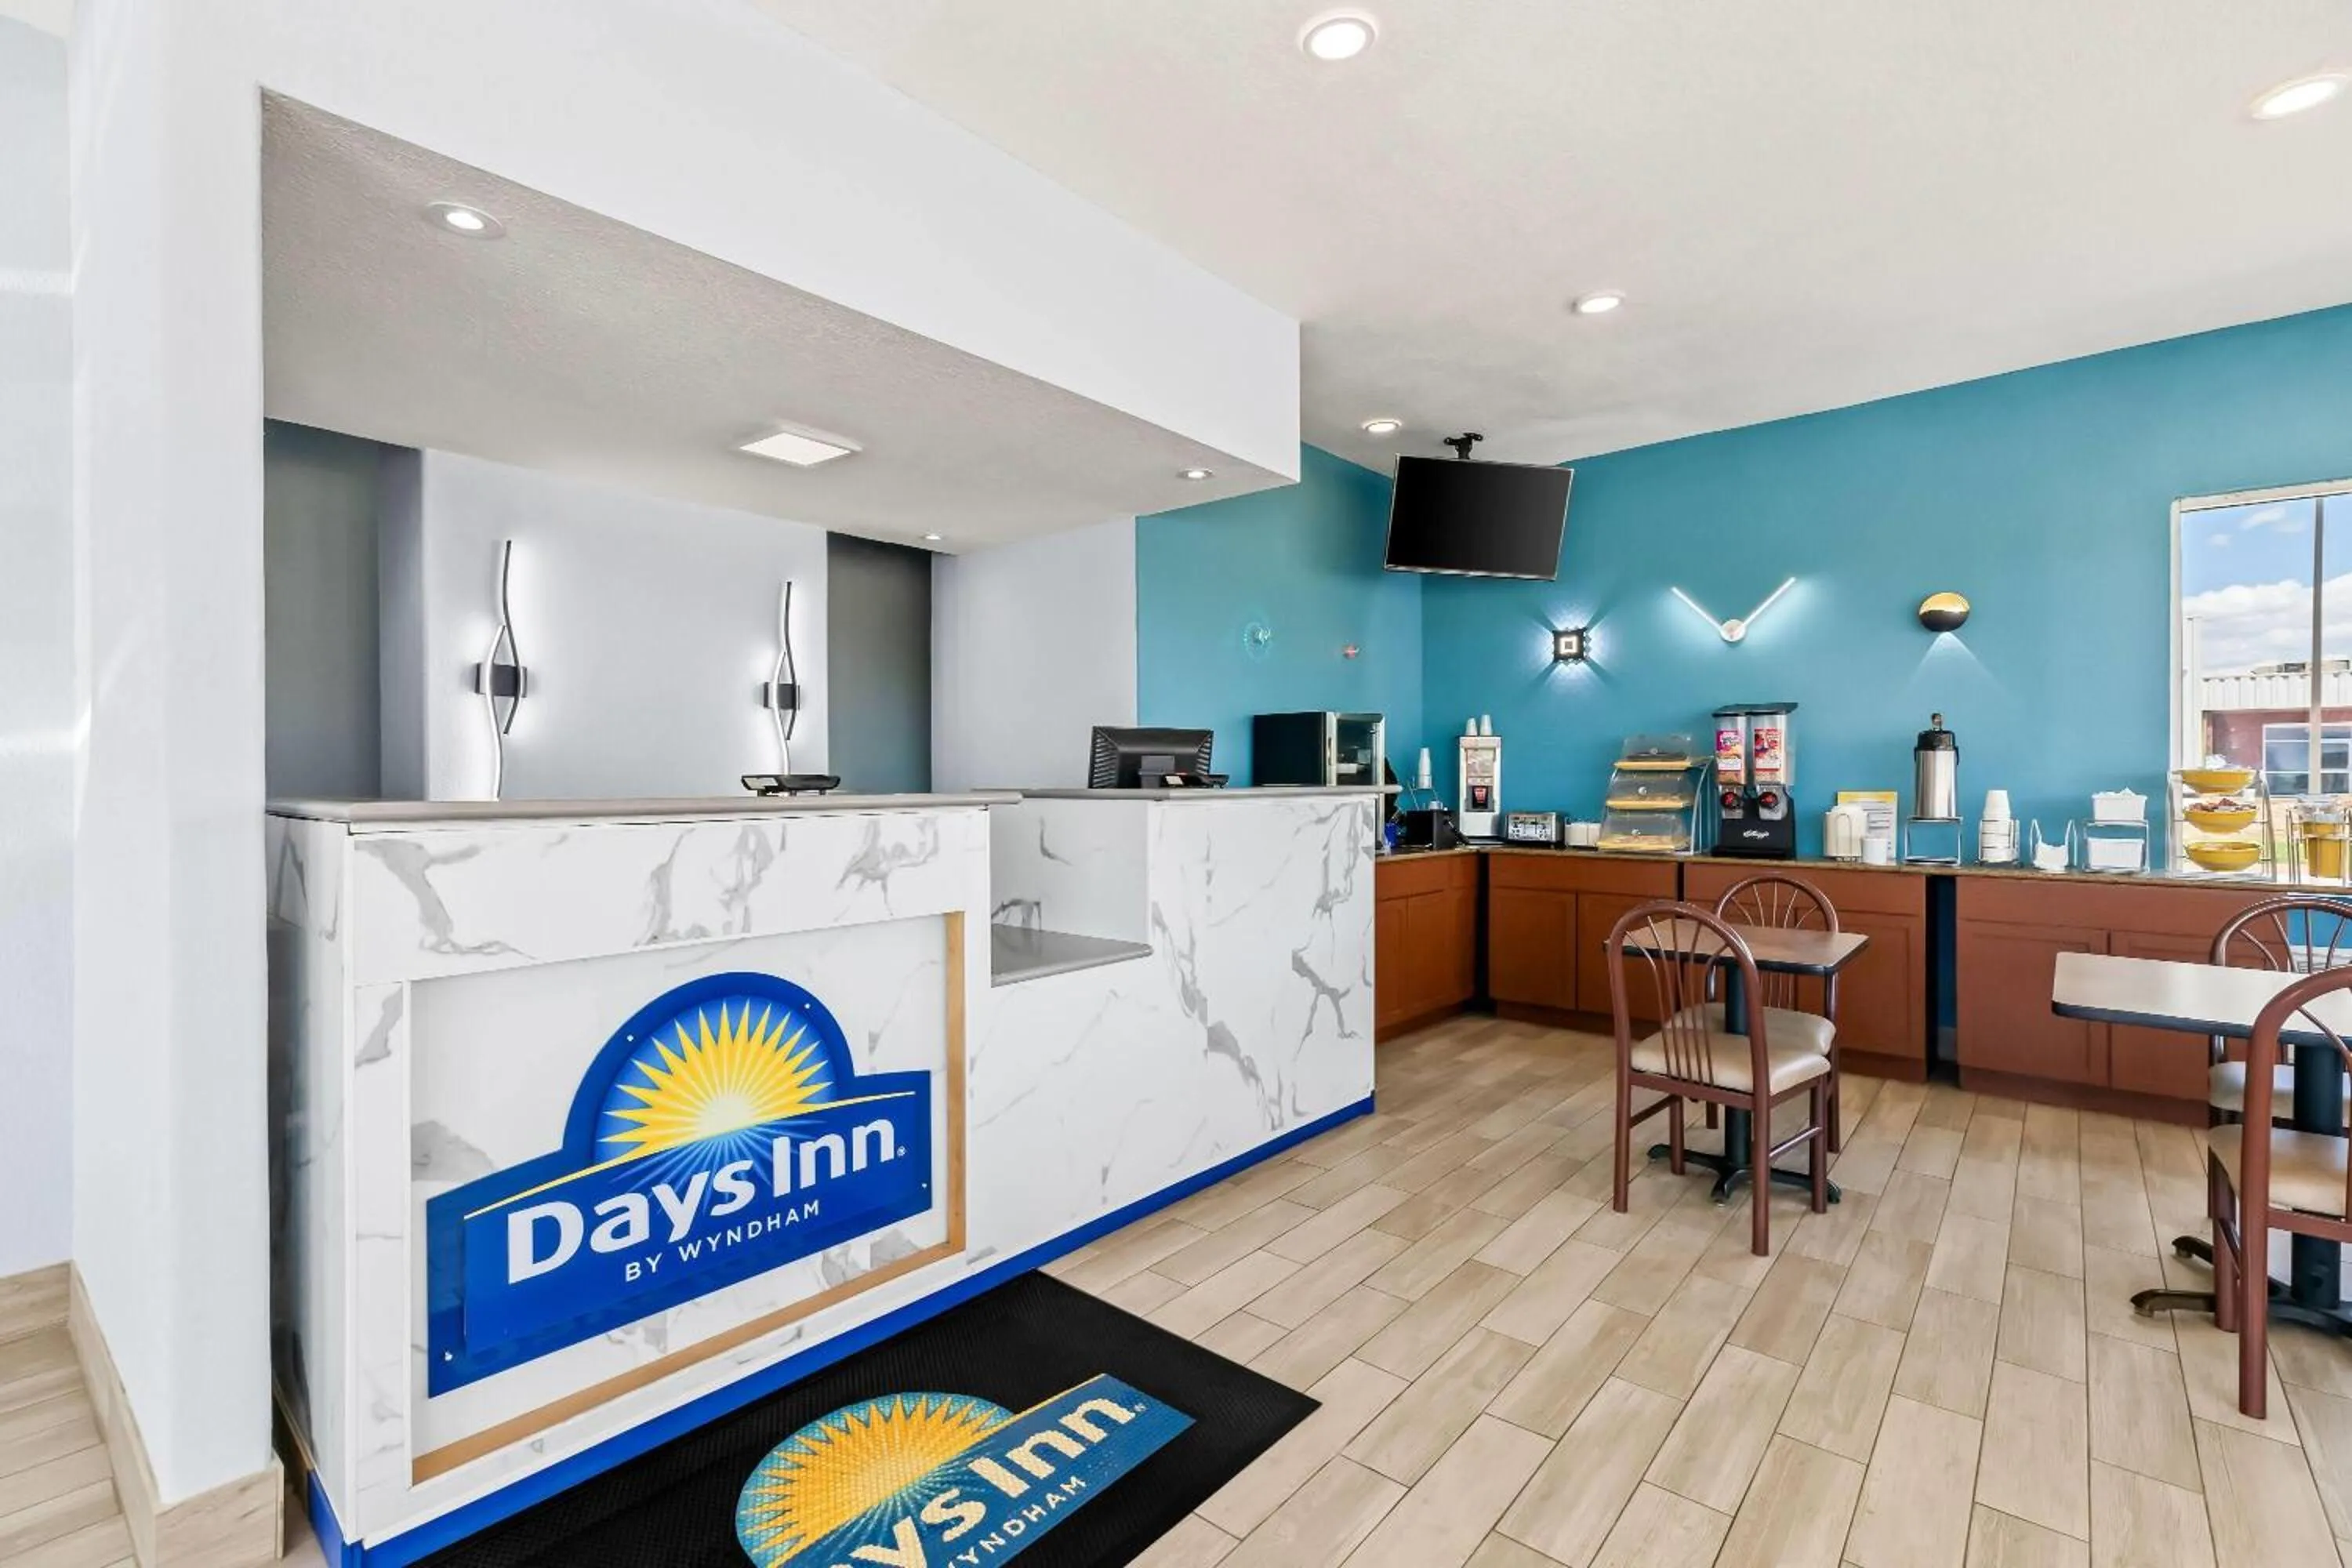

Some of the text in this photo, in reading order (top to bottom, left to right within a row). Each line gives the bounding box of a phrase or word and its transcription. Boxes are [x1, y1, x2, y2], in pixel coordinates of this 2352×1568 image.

[507, 1160, 755, 1284] Days
[625, 1200, 820, 1282] BY WYNDHAM
[829, 1488, 987, 1568] ys
[948, 1475, 1087, 1568] YNDHAM
